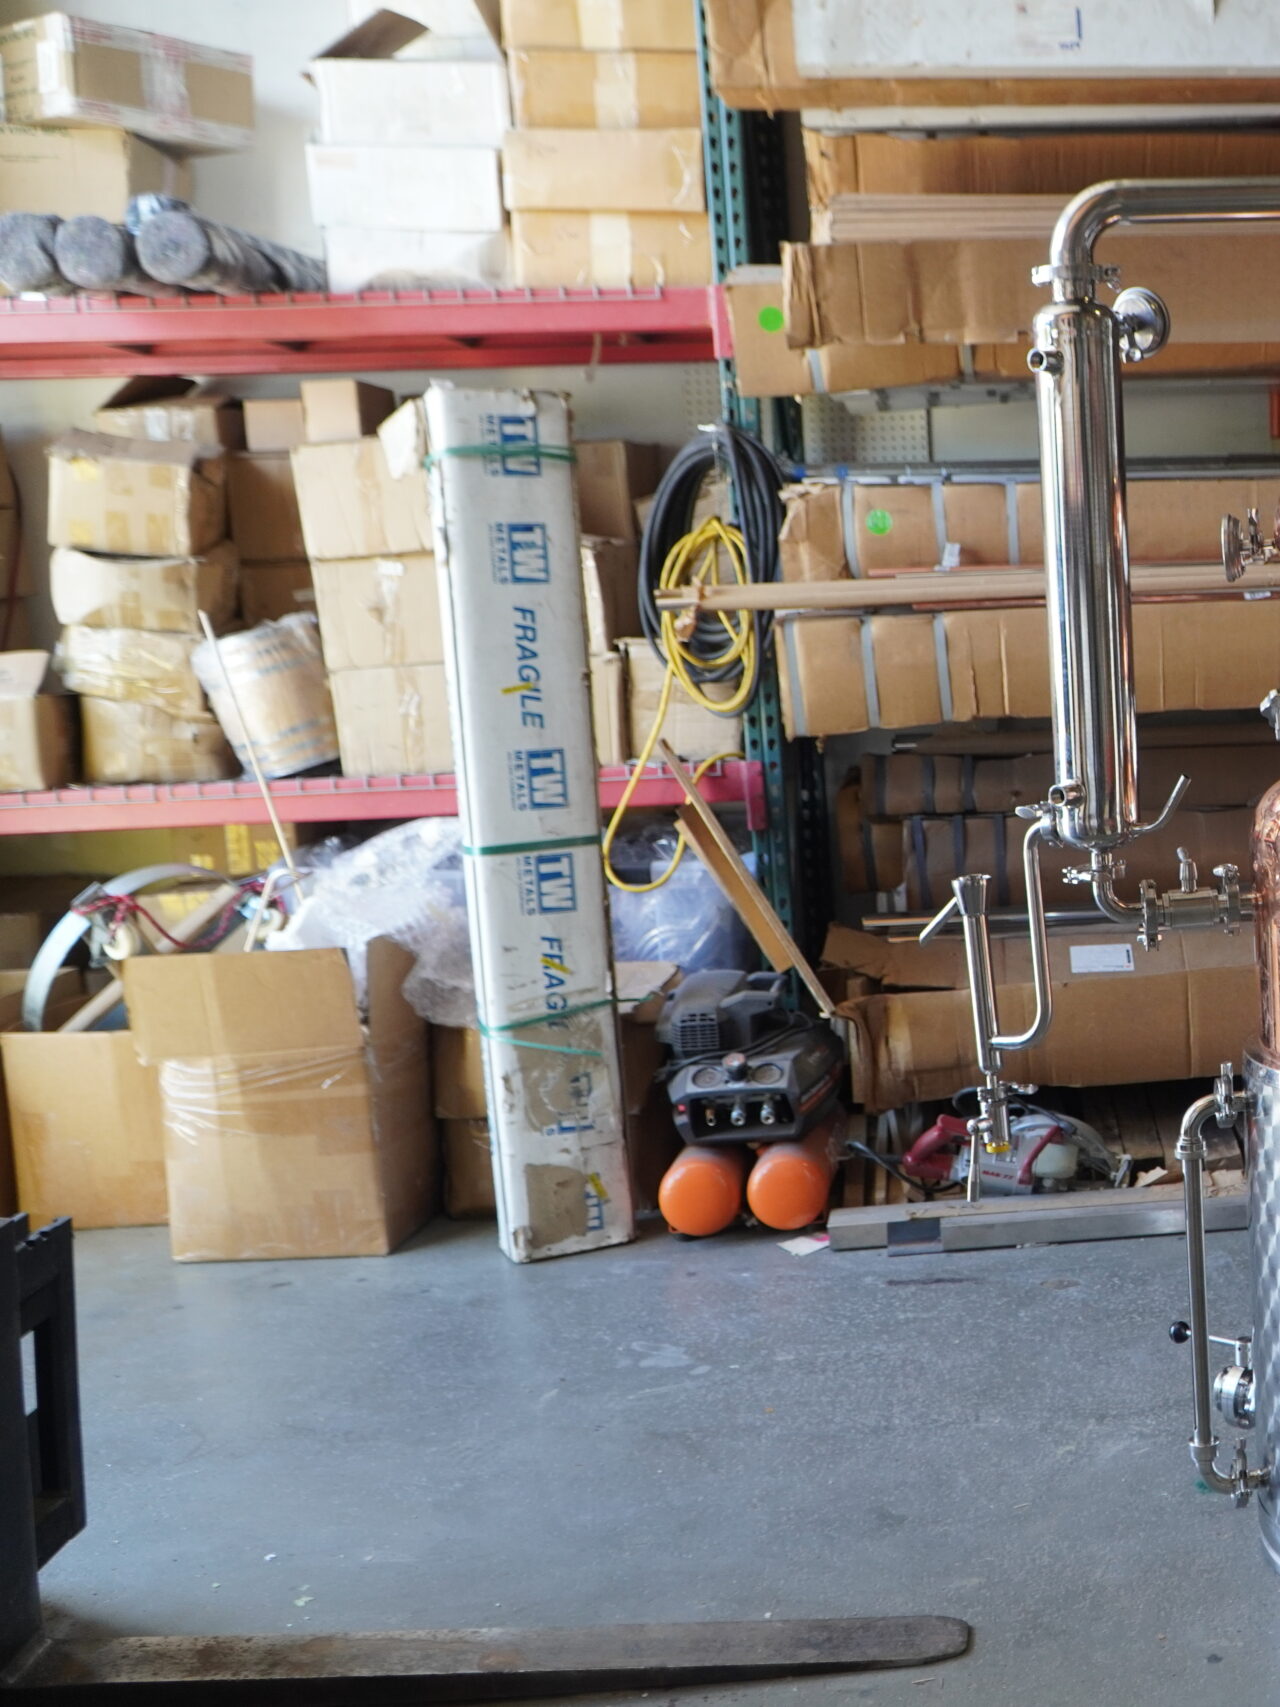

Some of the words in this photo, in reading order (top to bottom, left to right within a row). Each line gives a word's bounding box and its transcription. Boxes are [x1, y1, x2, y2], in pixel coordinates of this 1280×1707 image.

[496, 522, 509, 585] METALS
[508, 523, 550, 584] TW
[515, 749, 528, 812] METALS
[528, 747, 569, 810] TW
[523, 855, 537, 916] METALS
[536, 852, 577, 914] TW
